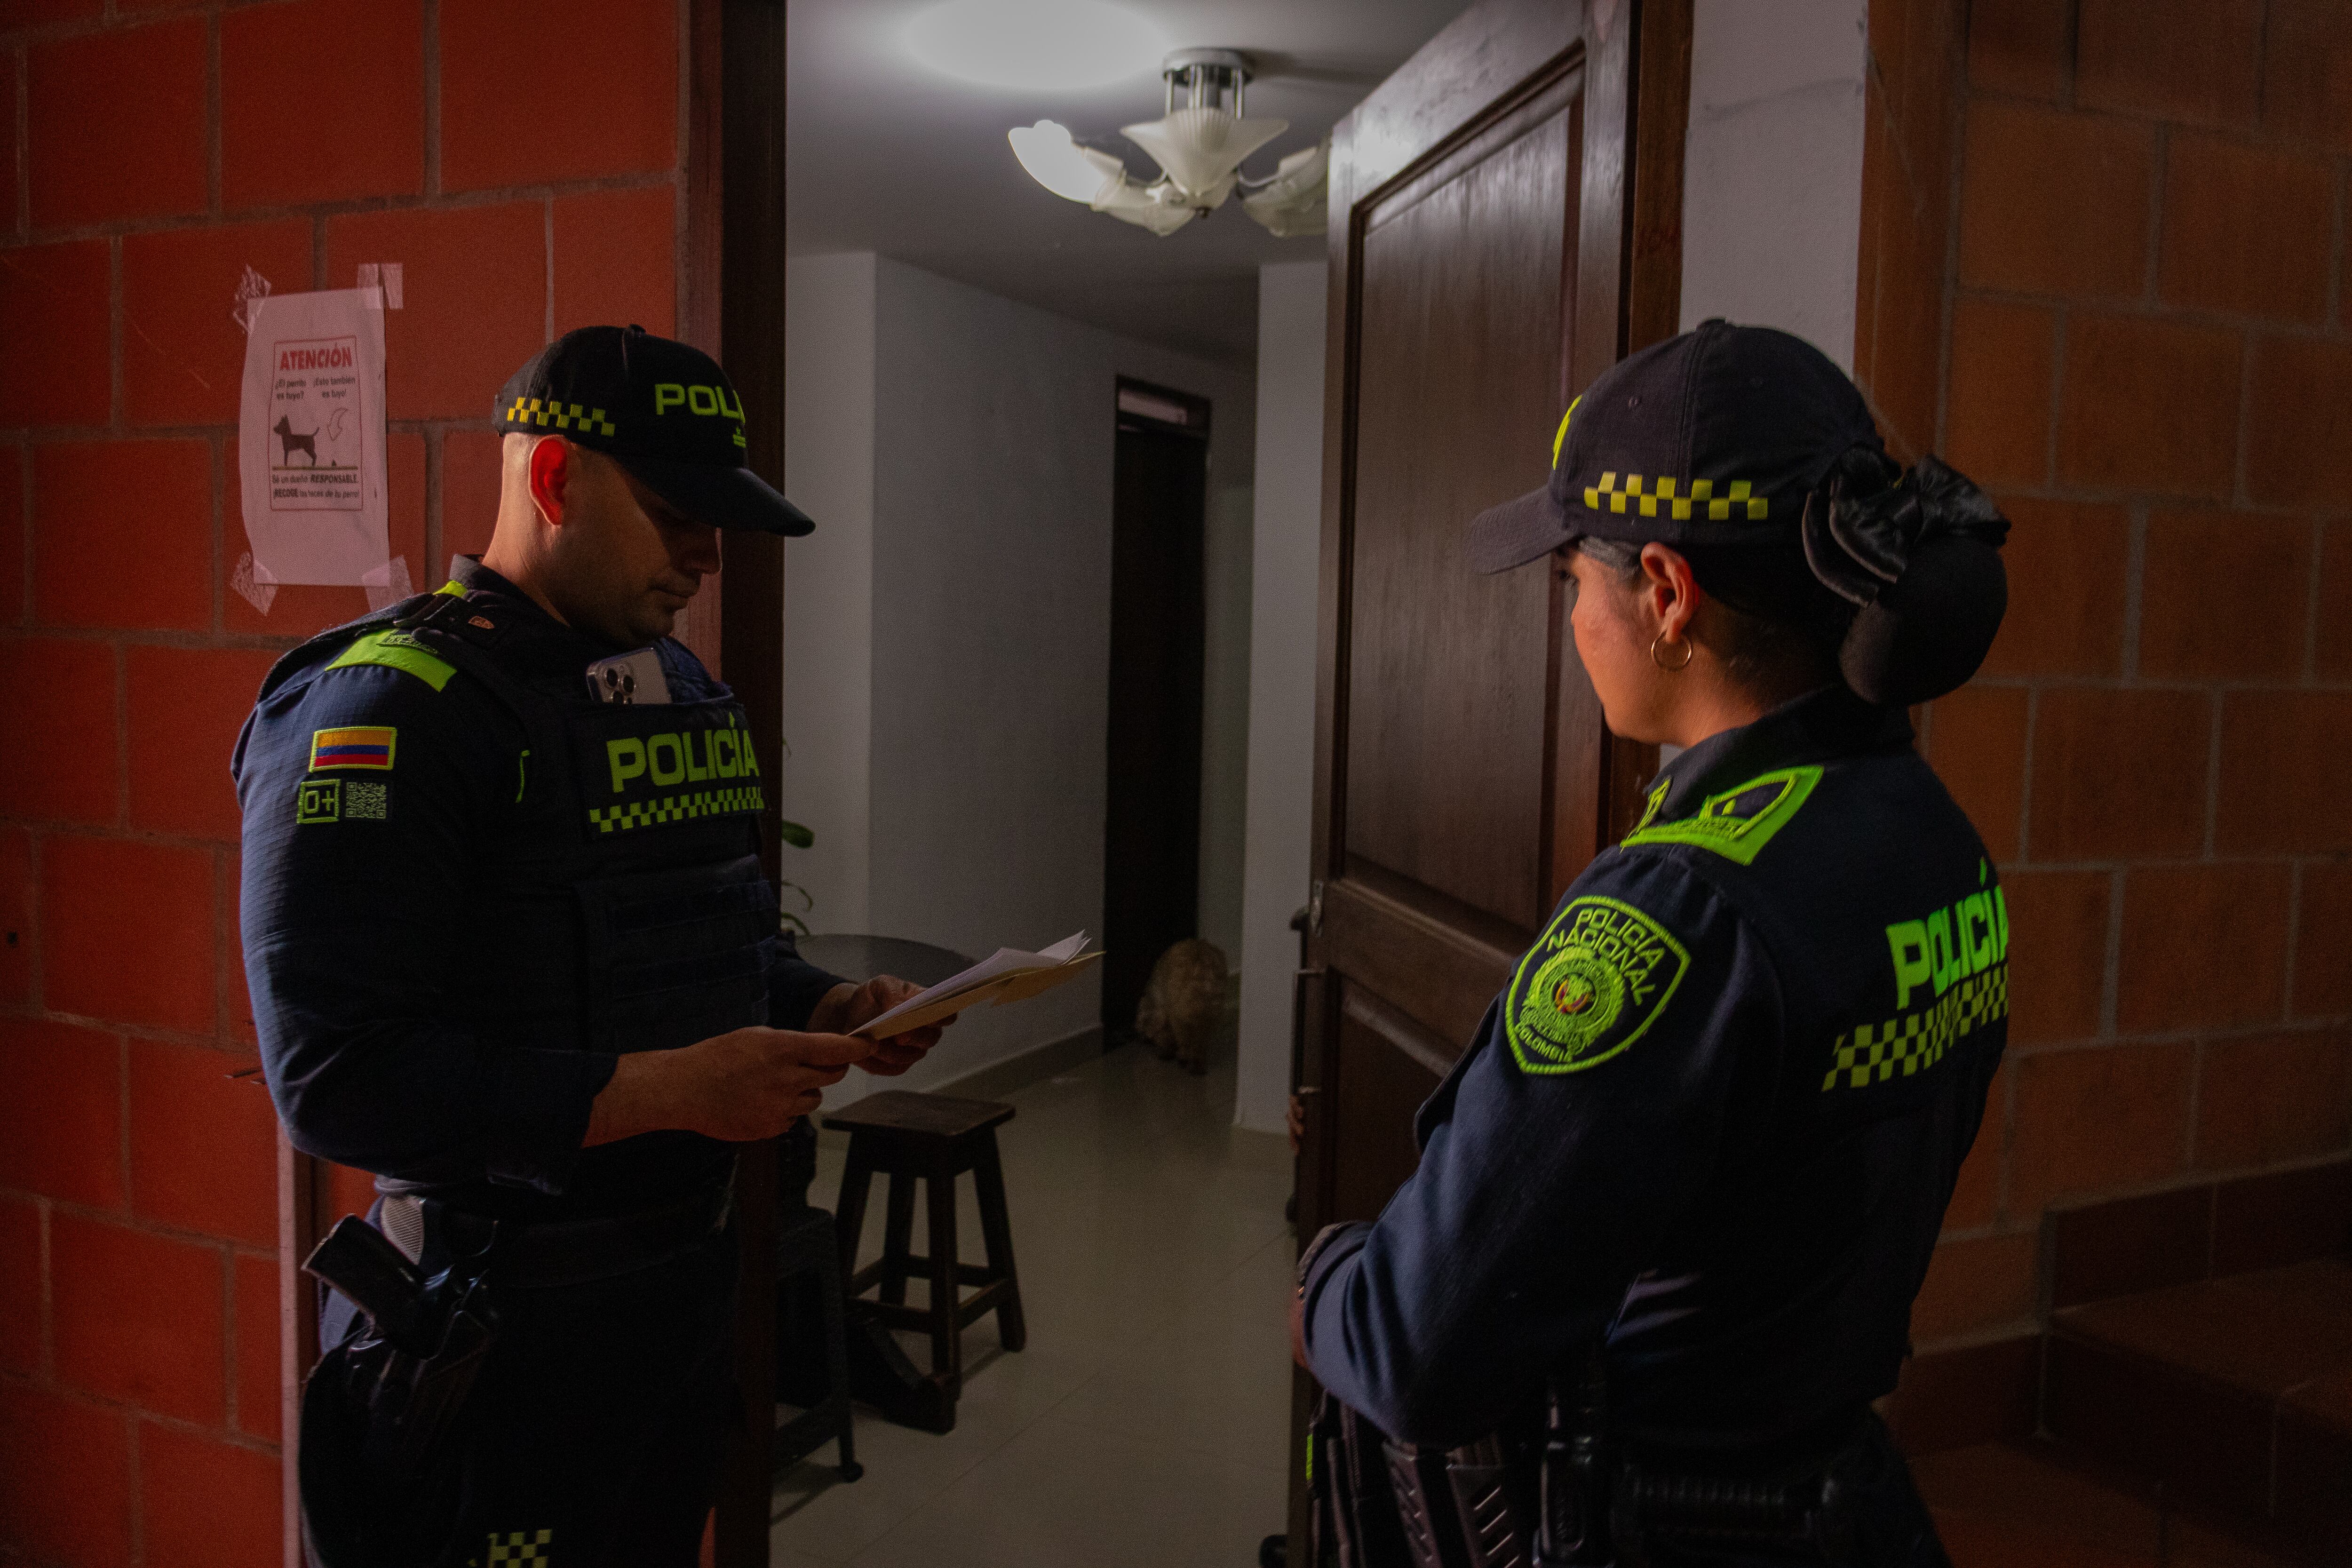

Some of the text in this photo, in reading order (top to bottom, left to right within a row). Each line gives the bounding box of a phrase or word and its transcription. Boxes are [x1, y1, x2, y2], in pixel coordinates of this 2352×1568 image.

[280, 342, 352, 370] ATENCIÓN
[331, 376, 356, 385] también
[286, 390, 304, 400] tuyo?
[606, 711, 760, 794] POLICÍA
[1546, 926, 1656, 1006] NACIONAL
